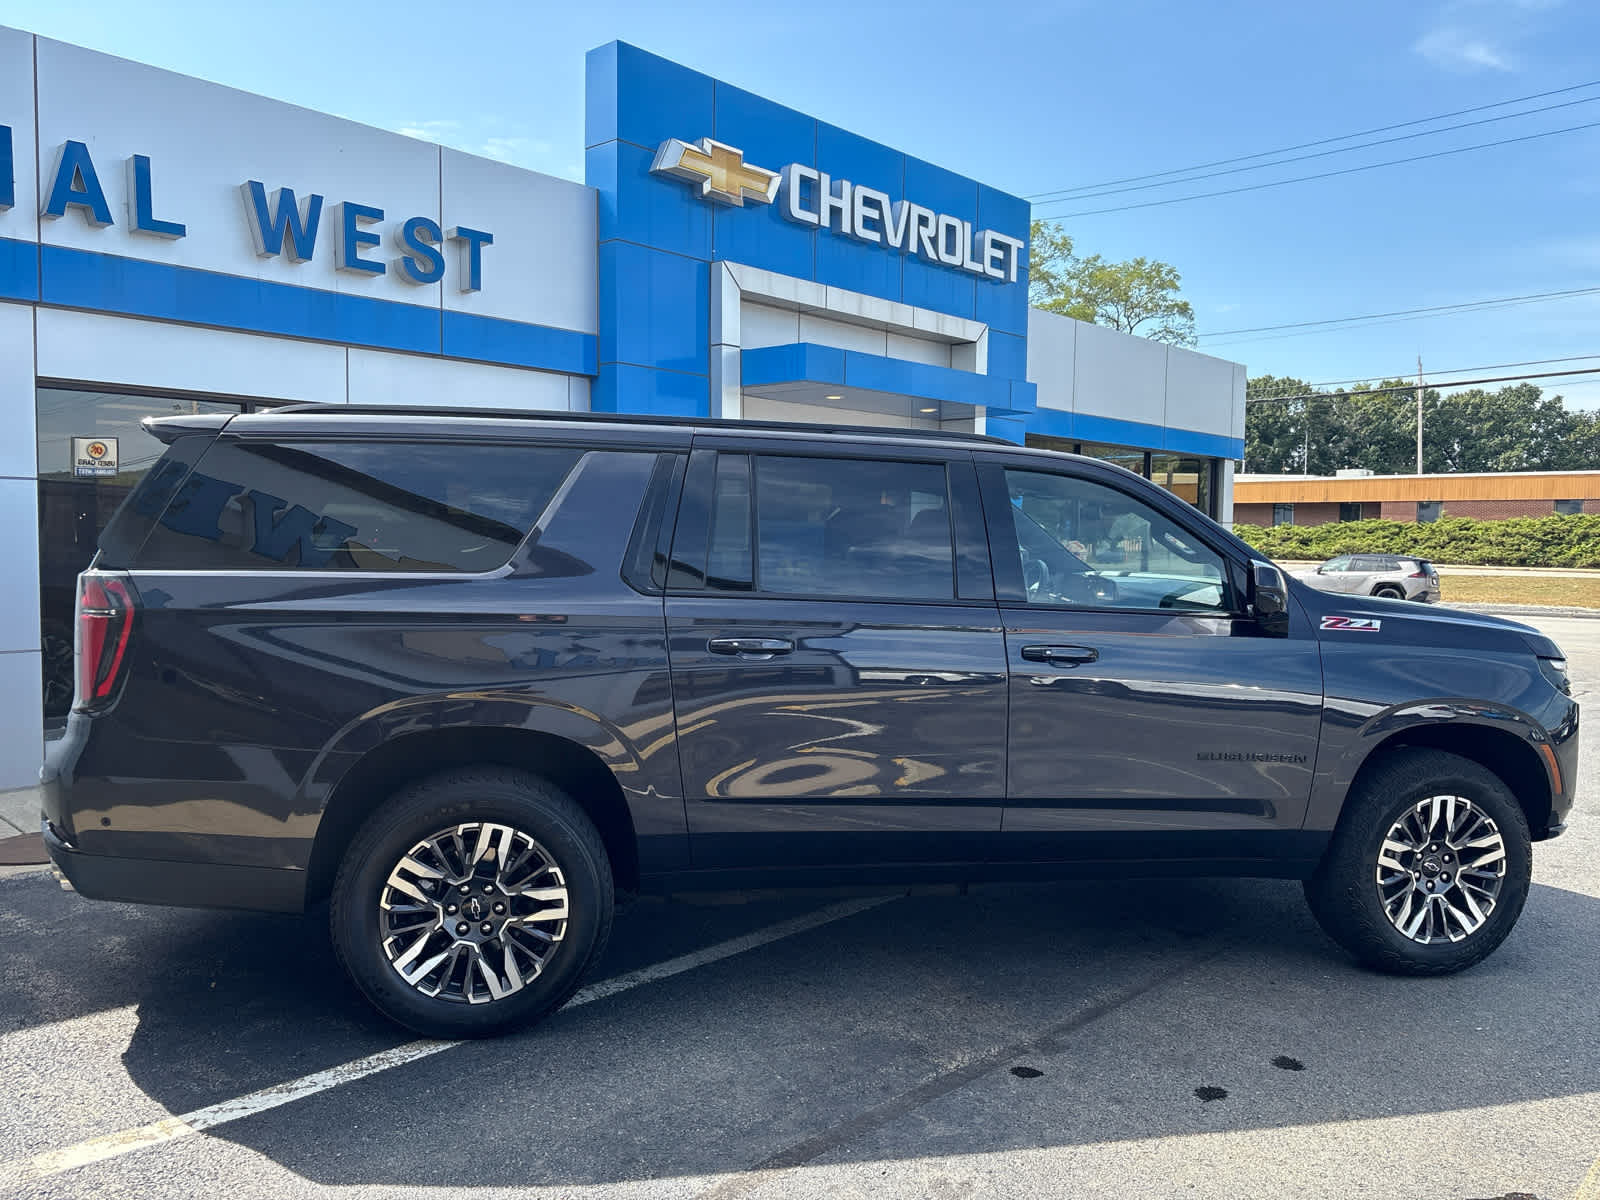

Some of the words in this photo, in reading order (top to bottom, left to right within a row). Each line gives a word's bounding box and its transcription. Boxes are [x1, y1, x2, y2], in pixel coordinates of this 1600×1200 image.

[240, 180, 494, 293] WEST
[781, 162, 1025, 283] CHEVROLET
[1320, 616, 1381, 632] Z71
